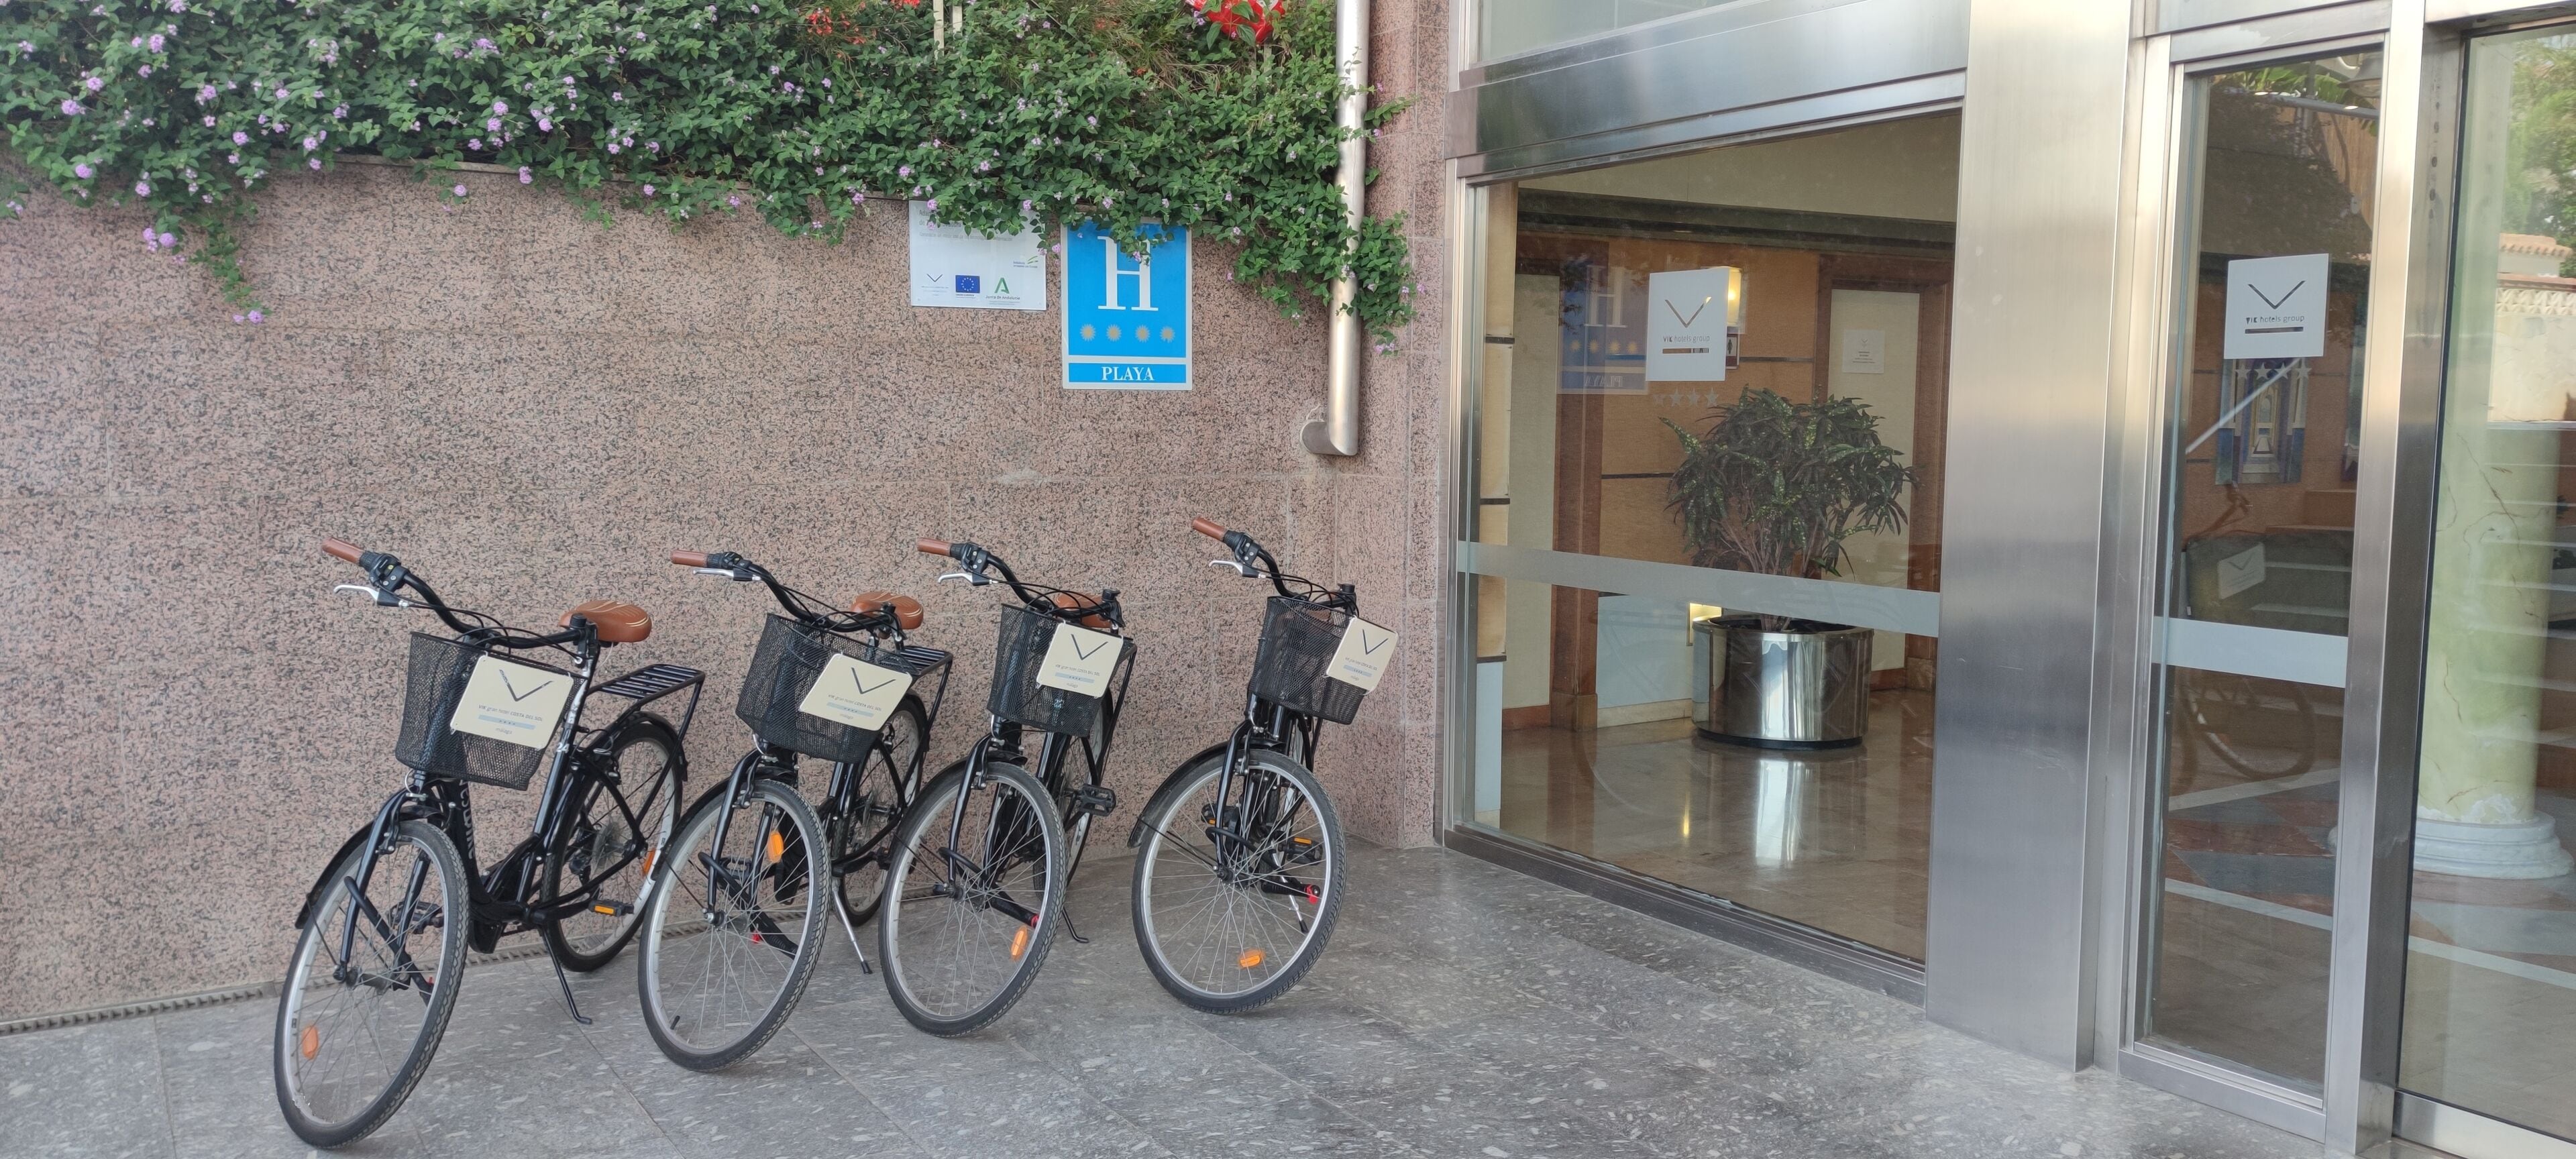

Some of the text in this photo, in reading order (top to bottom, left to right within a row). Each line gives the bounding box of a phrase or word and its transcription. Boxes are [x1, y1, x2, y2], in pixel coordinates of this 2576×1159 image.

[1097, 235, 1159, 311] H
[2283, 315, 2305, 323] group
[1693, 335, 1710, 343] group
[1101, 366, 1154, 382] PLAYA
[556, 741, 570, 753] 24
